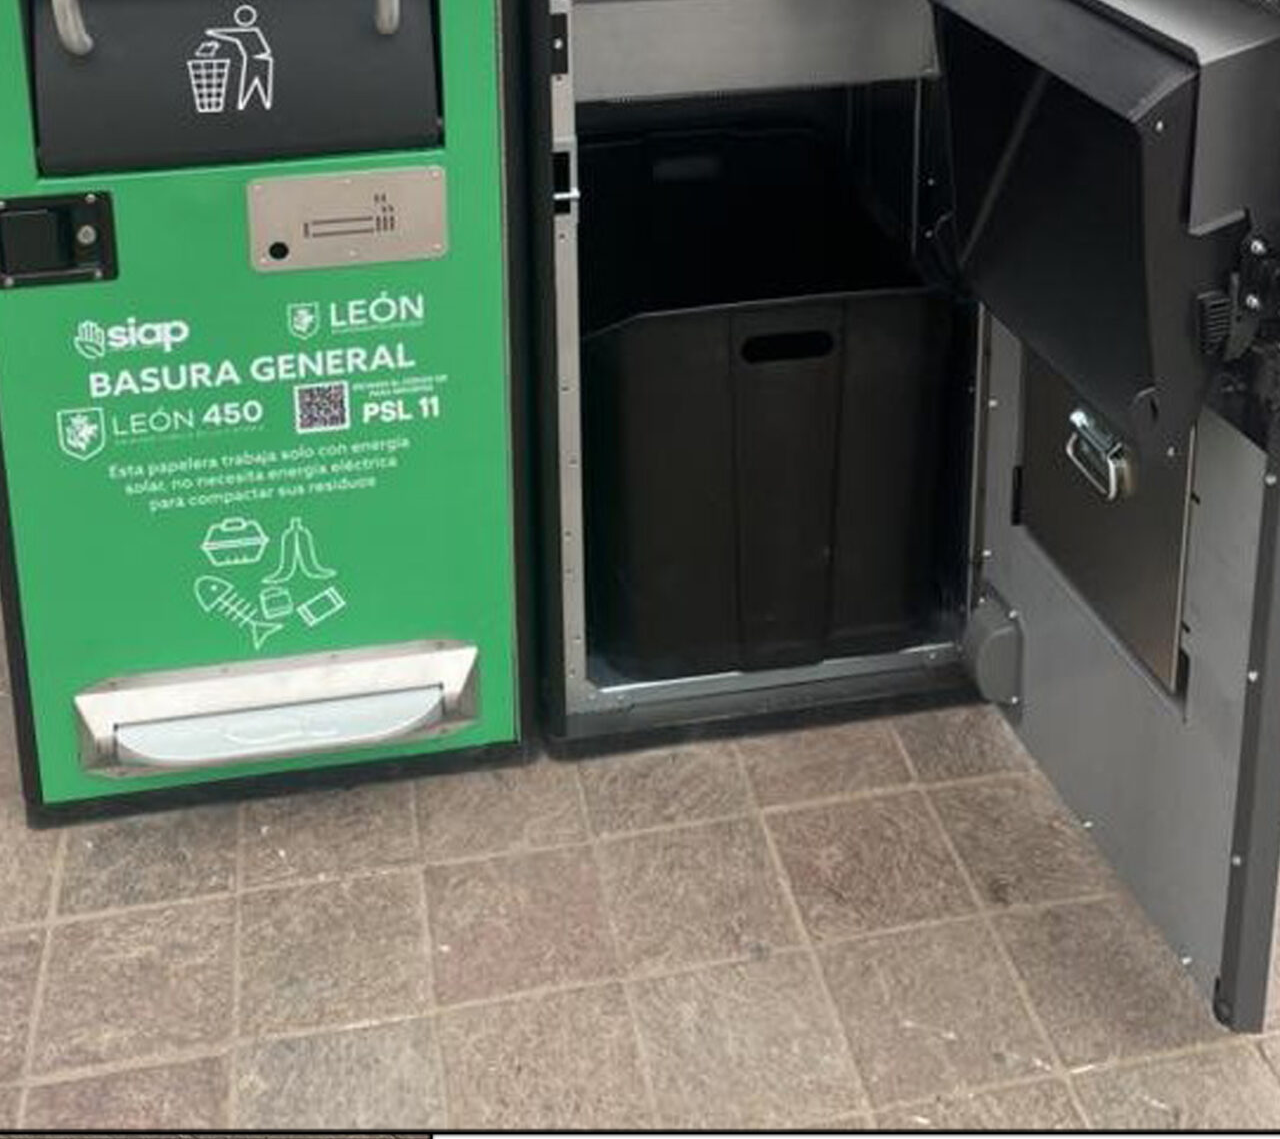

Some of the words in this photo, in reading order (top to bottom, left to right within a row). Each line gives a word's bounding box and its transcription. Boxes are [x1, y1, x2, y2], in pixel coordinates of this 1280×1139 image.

[330, 291, 424, 327] LEÓN
[108, 316, 189, 353] siap
[89, 360, 241, 399] BASURA
[250, 343, 416, 383] GENERAL
[112, 406, 195, 436] LEÓN
[202, 400, 264, 426] 450
[363, 400, 413, 424] PSL
[419, 395, 440, 418] 11
[108, 464, 144, 479] Esta
[171, 478, 194, 491] no
[148, 497, 185, 512] para
